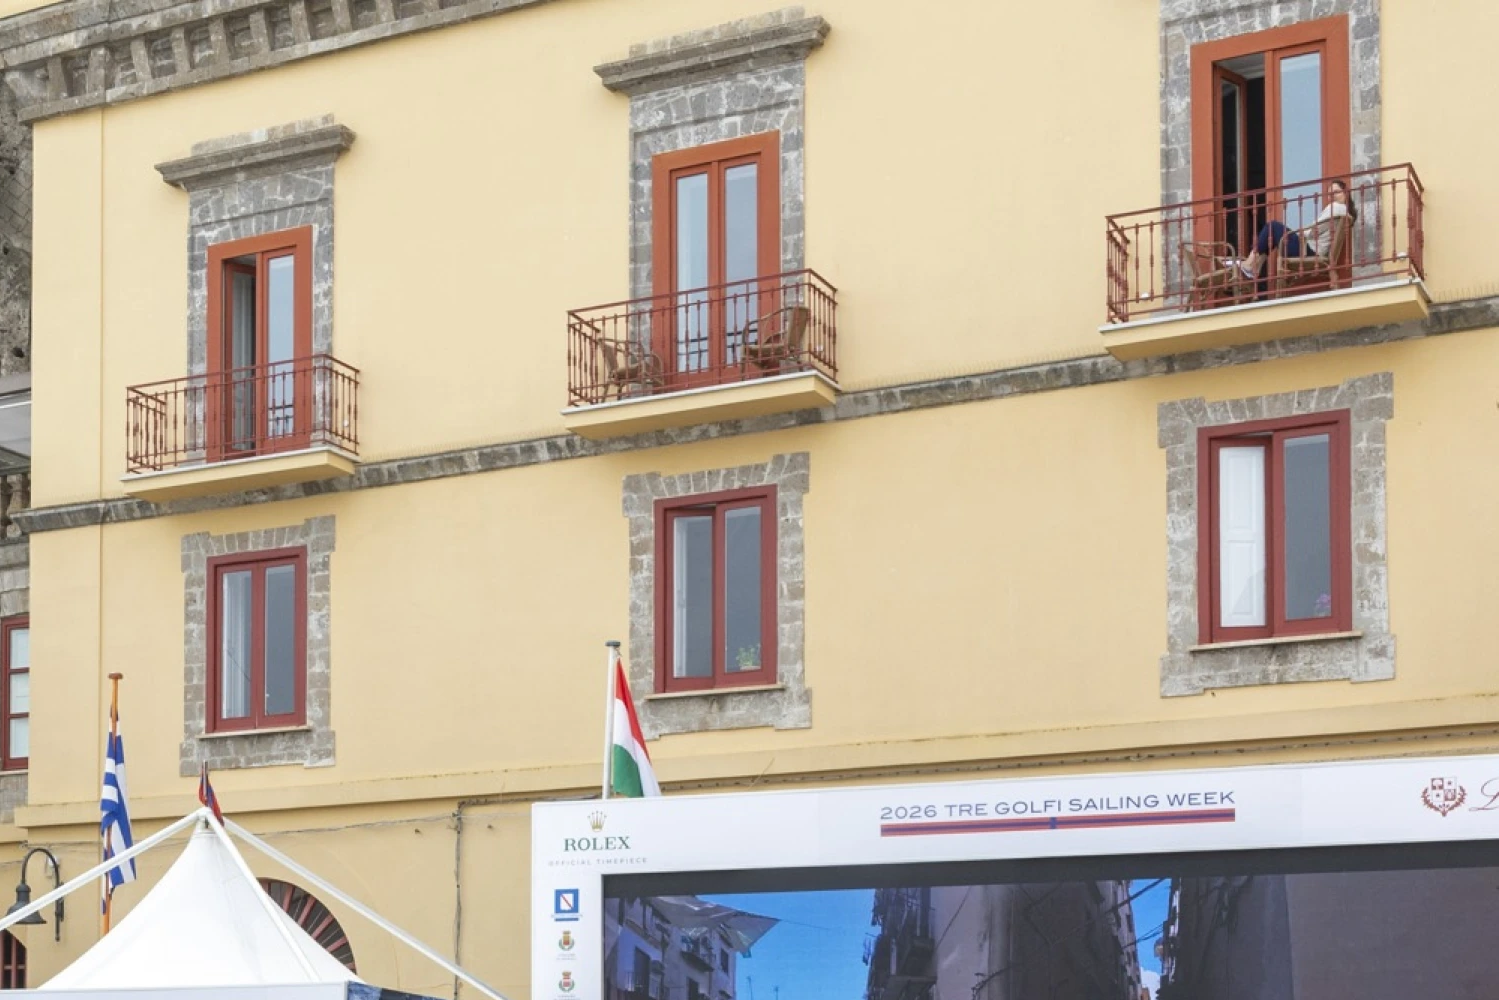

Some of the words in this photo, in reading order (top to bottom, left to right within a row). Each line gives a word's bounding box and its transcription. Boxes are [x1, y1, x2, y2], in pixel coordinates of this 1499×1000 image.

[880, 804, 938, 820] 2026
[945, 803, 988, 817] TRE
[994, 798, 1062, 817] GOLFI
[1068, 793, 1160, 813] SAILING
[1167, 790, 1236, 806] WEEK
[563, 836, 631, 852] ROLEX
